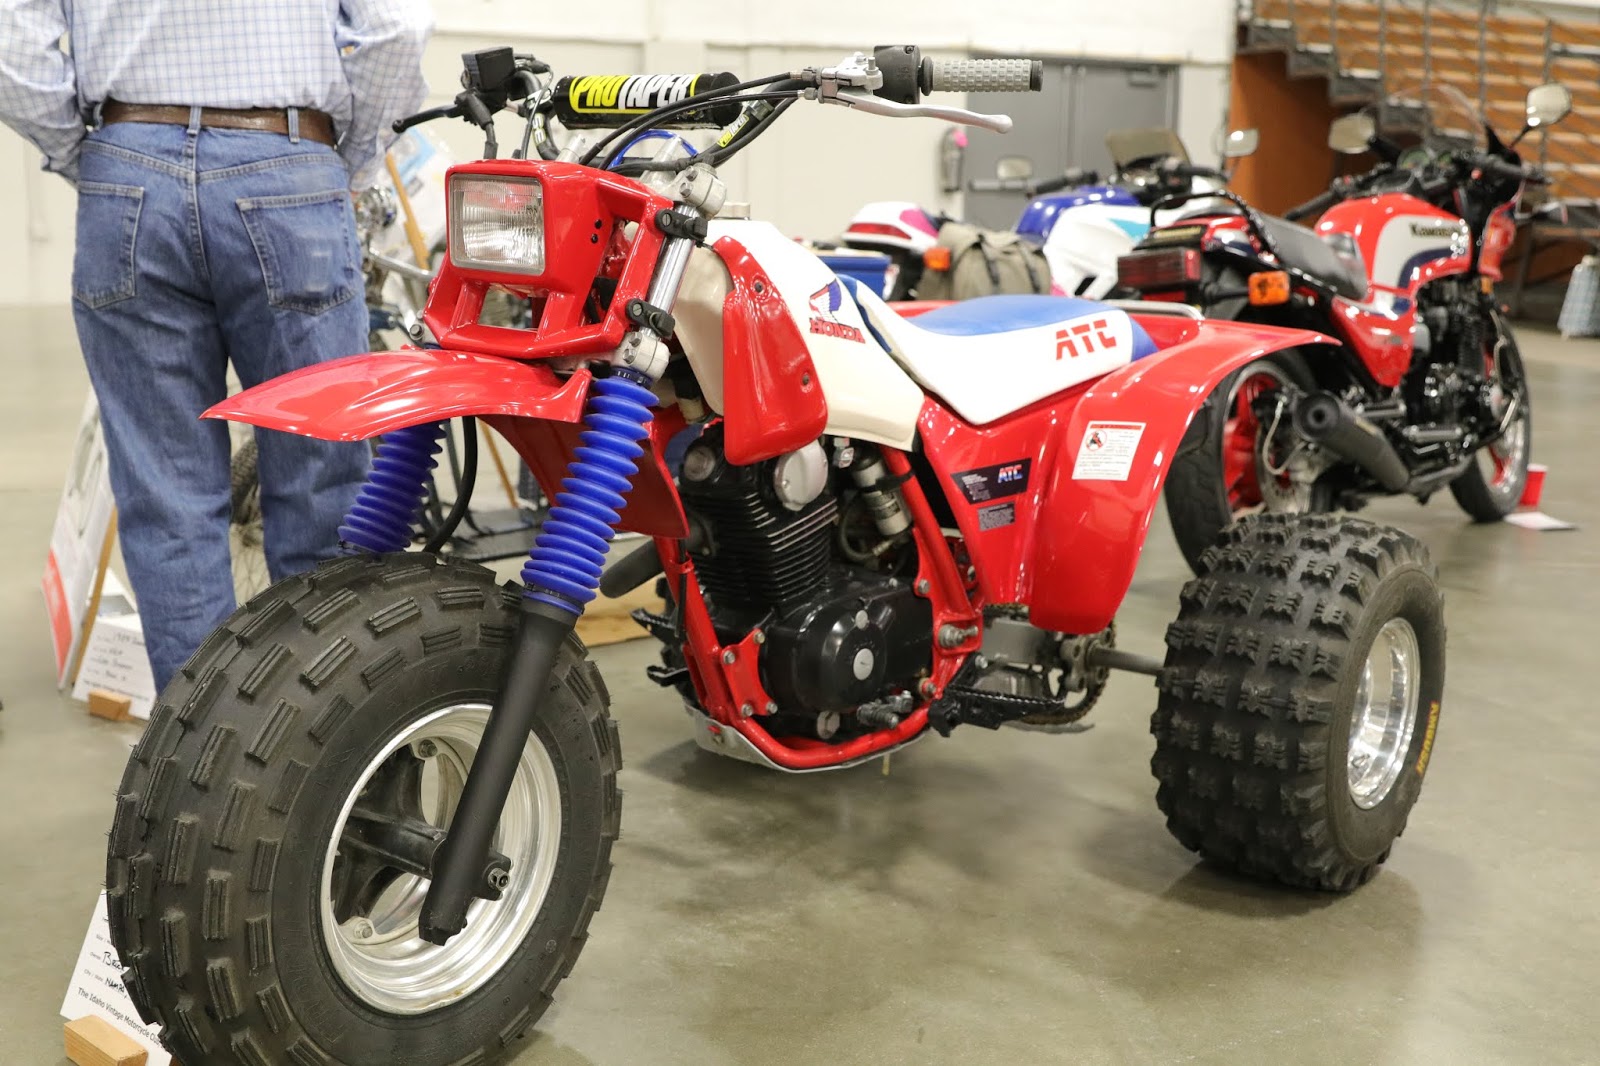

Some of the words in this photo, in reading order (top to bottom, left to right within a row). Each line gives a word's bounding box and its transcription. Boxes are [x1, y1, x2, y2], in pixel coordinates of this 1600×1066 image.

[809, 316, 866, 344] HONDA
[1056, 319, 1117, 360] ATC
[998, 464, 1023, 483] ATC
[78, 987, 89, 999] The
[90, 993, 105, 1009] Idaho
[105, 1003, 124, 1021] Vintage
[124, 1015, 150, 1038] Motorcycle
